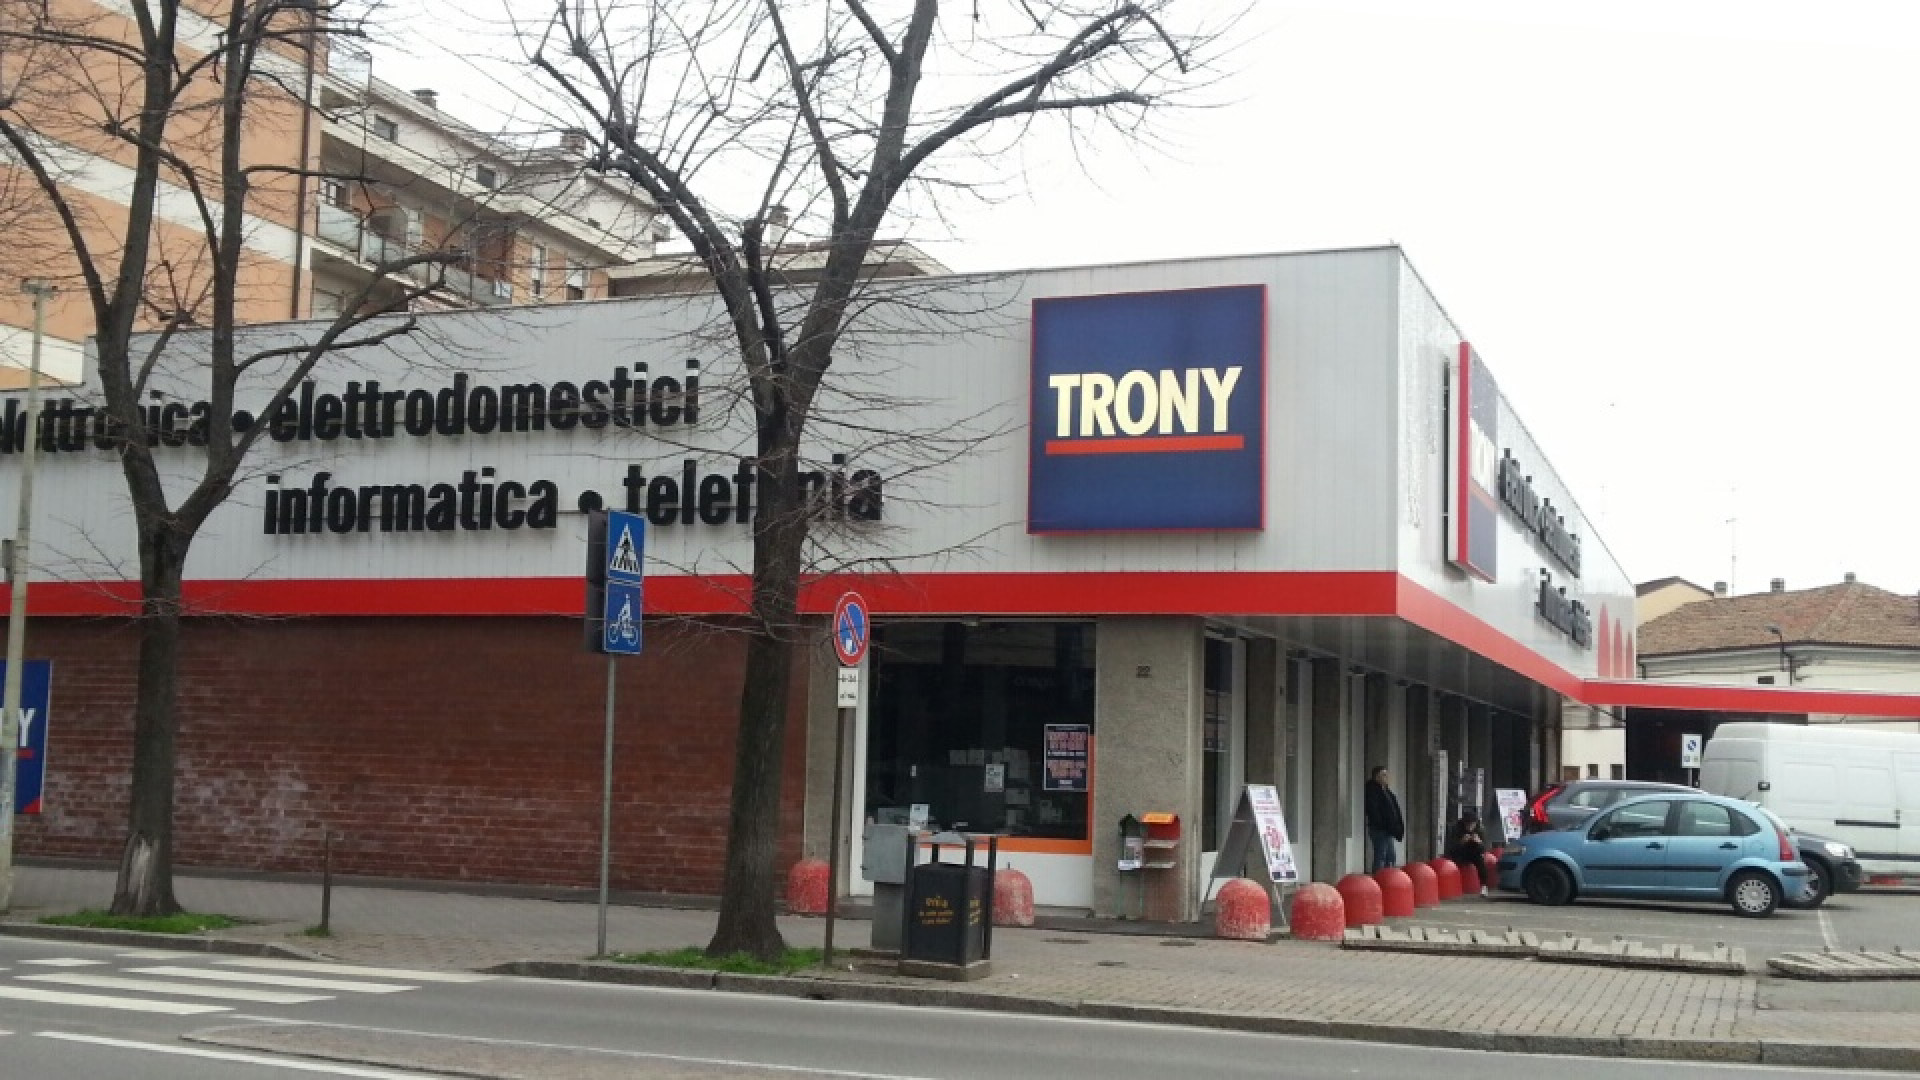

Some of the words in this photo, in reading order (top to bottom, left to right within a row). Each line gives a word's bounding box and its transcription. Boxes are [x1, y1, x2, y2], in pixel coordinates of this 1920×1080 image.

[268, 358, 700, 442] elettrodomestici
[1048, 365, 1243, 437] TRONY
[263, 466, 558, 535] informatica
[623, 453, 882, 526] telefnia
